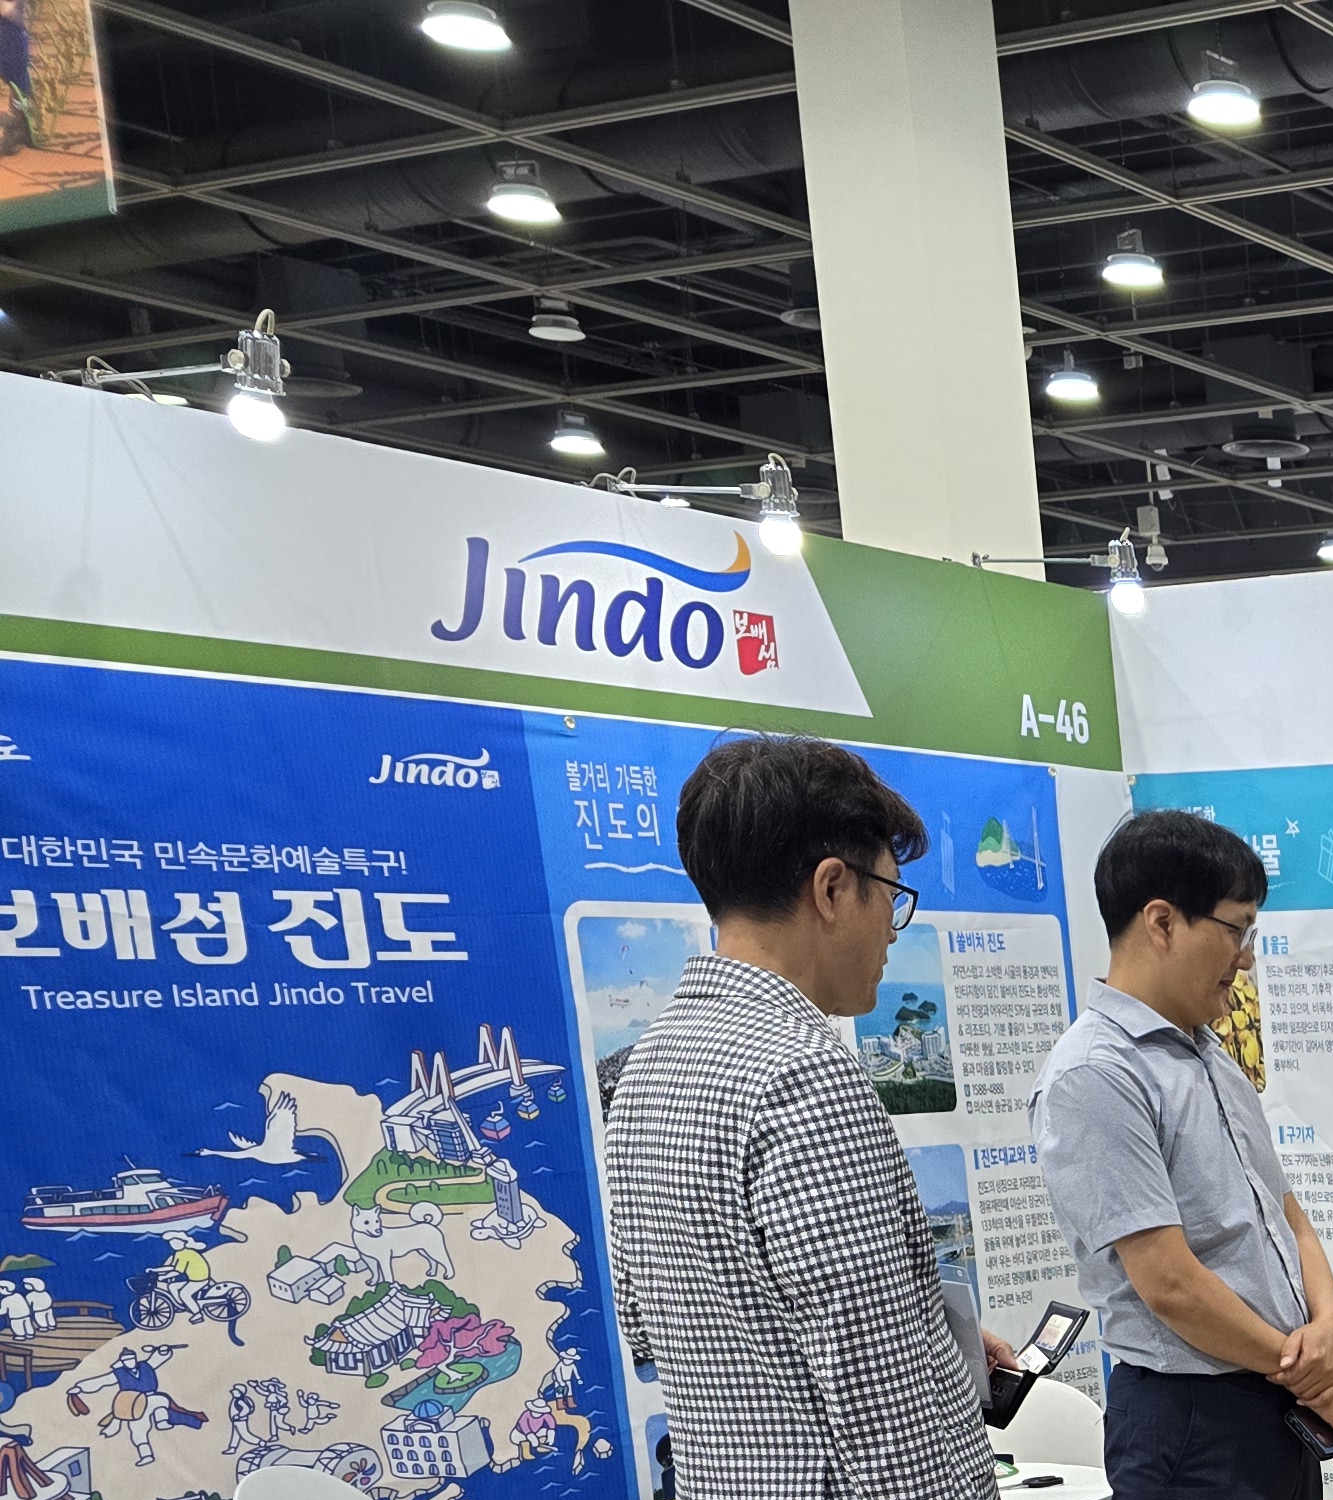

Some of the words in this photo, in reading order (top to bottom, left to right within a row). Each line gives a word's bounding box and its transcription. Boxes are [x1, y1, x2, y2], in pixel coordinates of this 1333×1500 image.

[431, 536, 724, 670] Jindo
[734, 610, 779, 672] 보배섬
[1021, 693, 1090, 745] A-46
[369, 754, 478, 788] Jindo
[566, 759, 610, 794] 볼거리
[614, 763, 658, 797] 가득한
[574, 799, 662, 850] 진도의
[2, 835, 143, 870] 대한민국
[153, 840, 408, 877] 민속문화예술특구!
[267, 888, 469, 970] 진도
[956, 930, 985, 953] 쏠비치
[987, 932, 1006, 953] 진도
[1270, 935, 1289, 955] 울금
[1265, 965, 1283, 978] 진도는
[21, 985, 163, 1010] Treasure
[172, 981, 259, 1008] Island
[268, 981, 345, 1007] Jindo
[350, 979, 435, 1004] Travel
[1286, 1125, 1315, 1144] 구기자
[981, 1145, 1026, 1169] 진도대교와
[1028, 1144, 1038, 1164] 명
[1281, 1154, 1294, 1167] 진도
